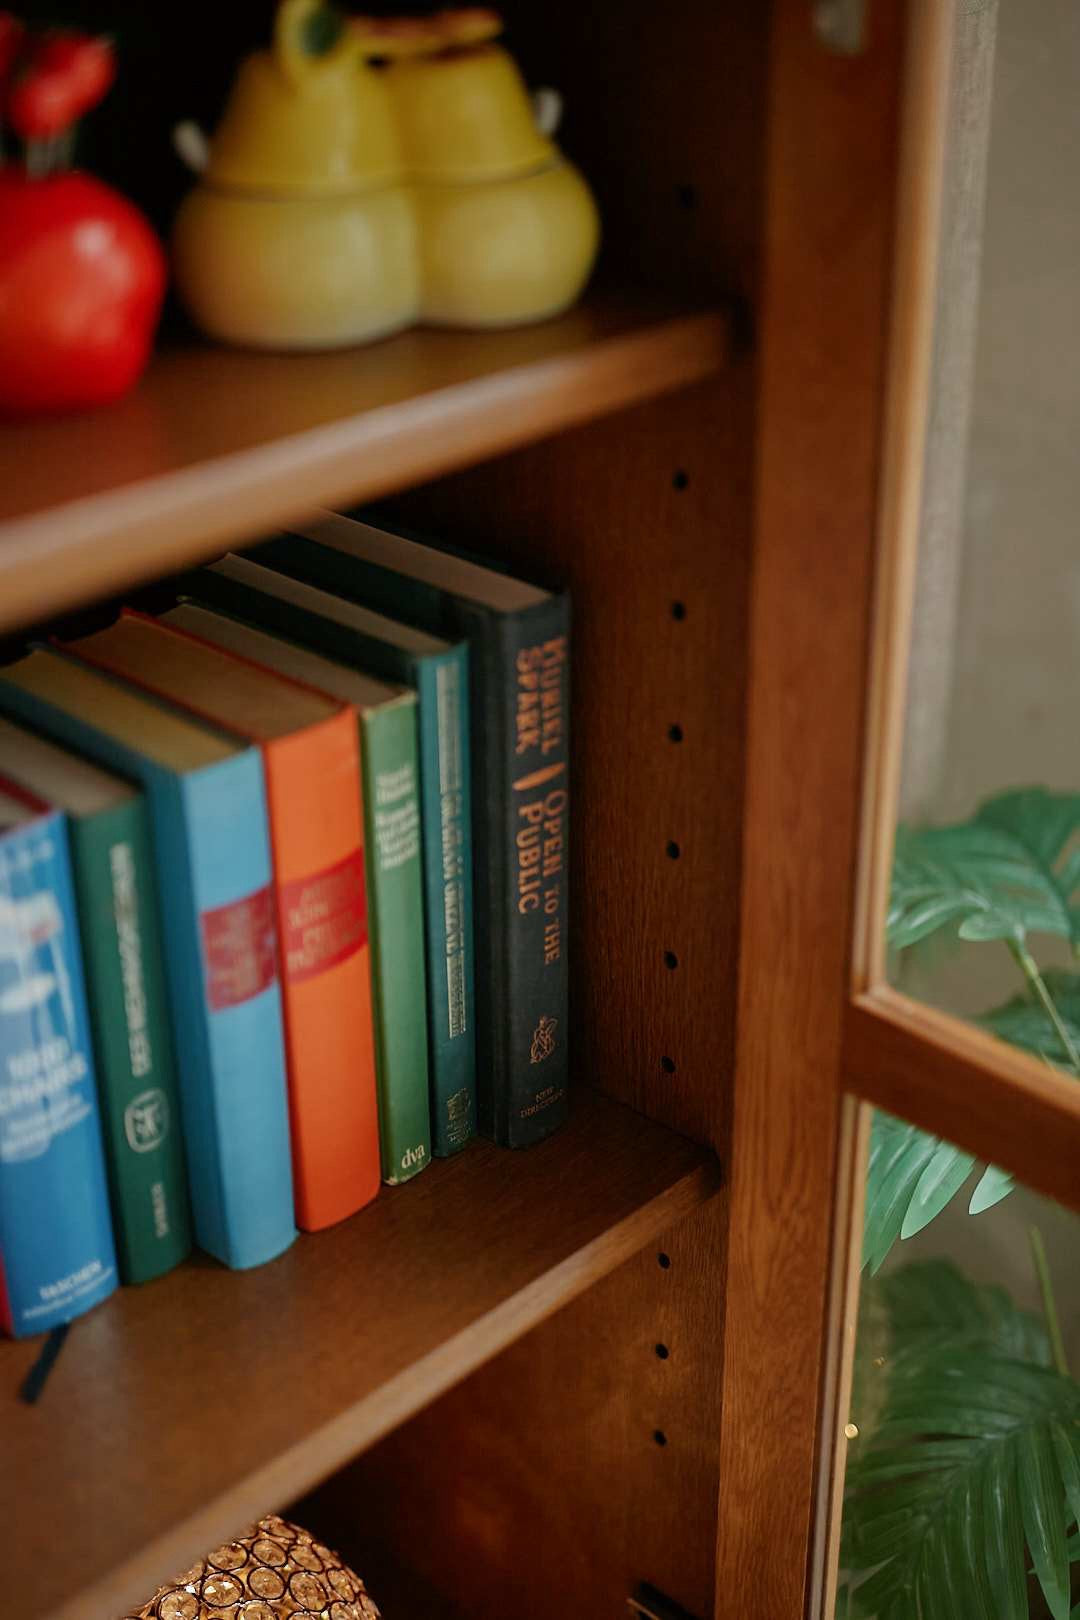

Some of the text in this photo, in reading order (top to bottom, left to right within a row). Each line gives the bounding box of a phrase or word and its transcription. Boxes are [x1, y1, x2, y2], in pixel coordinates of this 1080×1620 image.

[515, 648, 540, 754] SPARK
[516, 801, 545, 914] PUBLIC
[543, 789, 568, 877] OPEN
[543, 917, 561, 967] THE
[401, 1144, 425, 1169] dva
